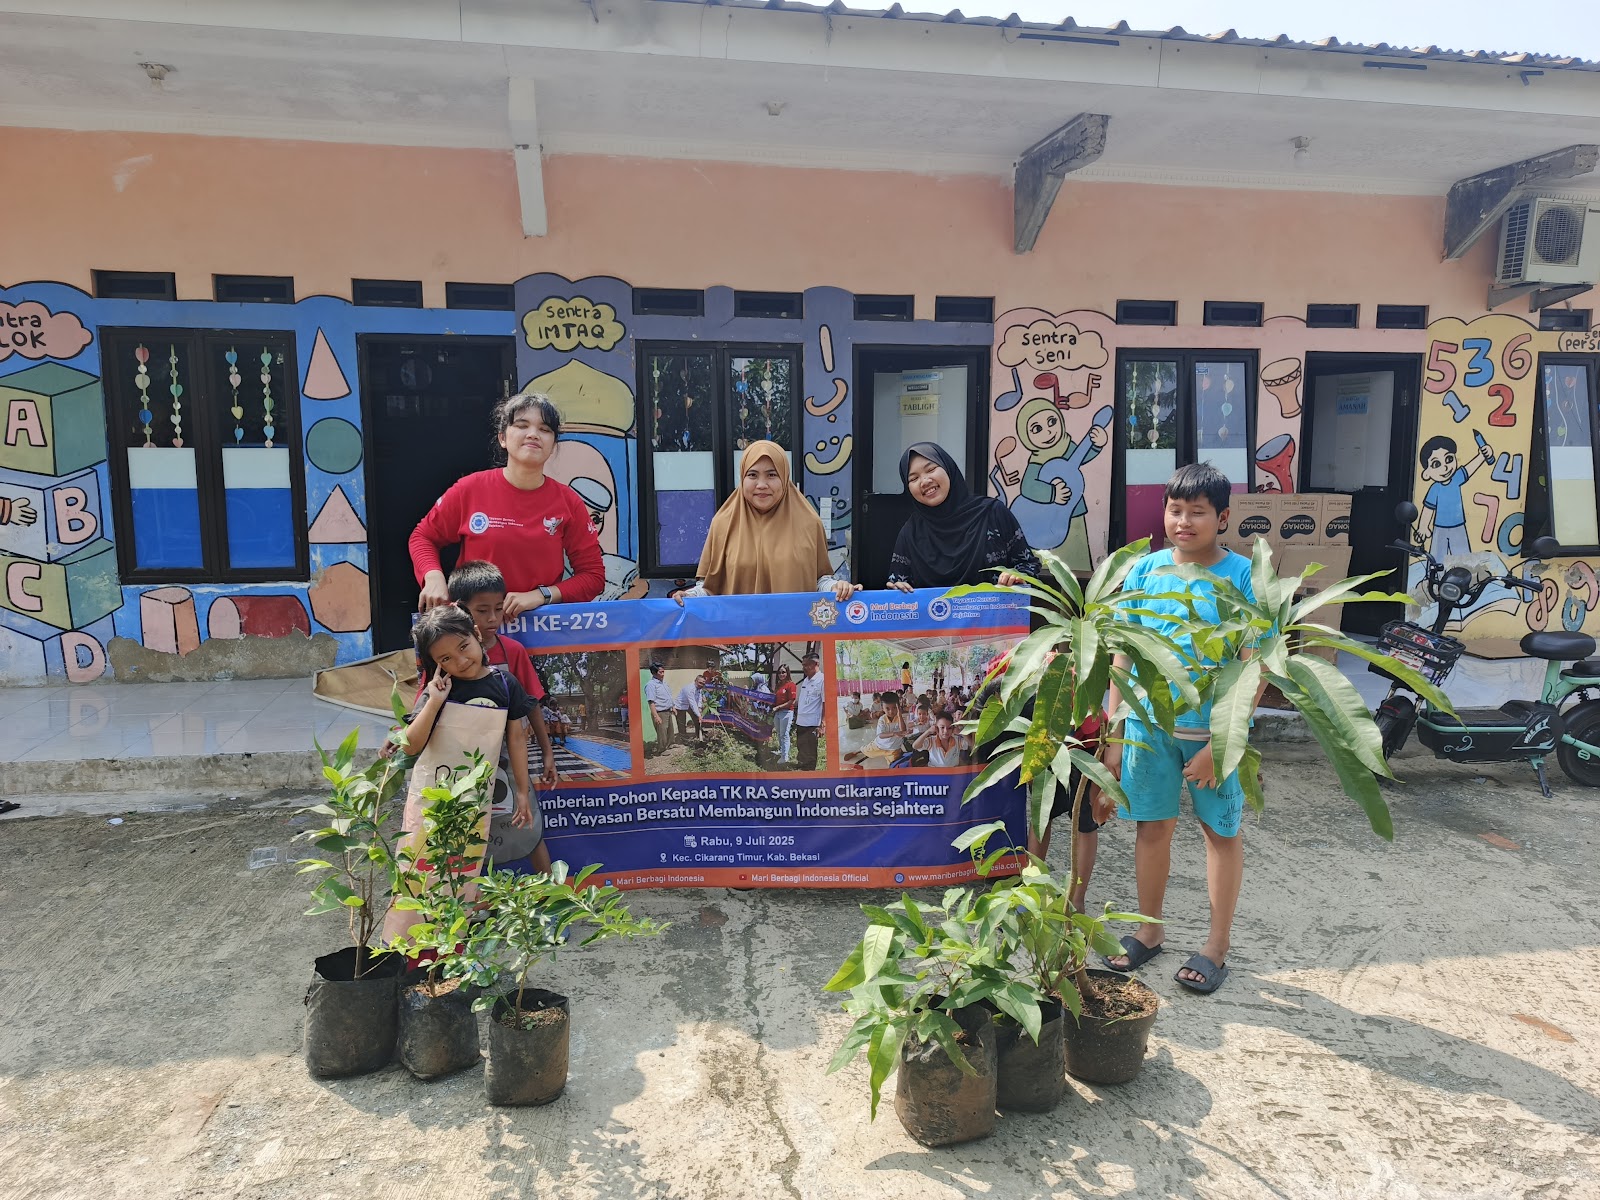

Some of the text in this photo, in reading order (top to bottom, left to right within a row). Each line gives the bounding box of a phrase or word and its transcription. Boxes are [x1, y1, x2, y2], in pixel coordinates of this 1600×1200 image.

[538, 323, 605, 340] IMTAQ
[1424, 333, 1532, 394] 5 3 6
[903, 403, 935, 411] TABLIGH
[1442, 384, 1517, 427] 1 2
[5, 399, 48, 447] A
[1490, 451, 1523, 500] 4
[52, 486, 98, 545] B
[1473, 492, 1500, 544] 7
[6, 561, 43, 612] C
[870, 603, 888, 611] Mari
[889, 602, 918, 611] Berbagi
[871, 610, 920, 621] Indonesia
[533, 611, 608, 632] KE-273
[60, 630, 107, 683] D
[539, 781, 950, 810] mberian Pohon Kepada TK RA Senyum Cikarang Timur
[544, 800, 945, 829] leh Yayasan Bersatu Membangun Indonesia Sejahtera
[700, 835, 795, 847] Rabu, 9 Juli 2025
[672, 853, 820, 863] Kec. Cikarang Timur, Kab. Bekasi
[616, 877, 634, 886] Mari
[636, 874, 666, 885] Berbagi
[667, 874, 705, 883] Indonesia
[751, 873, 869, 883] Mari Berbagi Indonesia Official
[908, 862, 1022, 882] www.mariberbagiinesia.com
